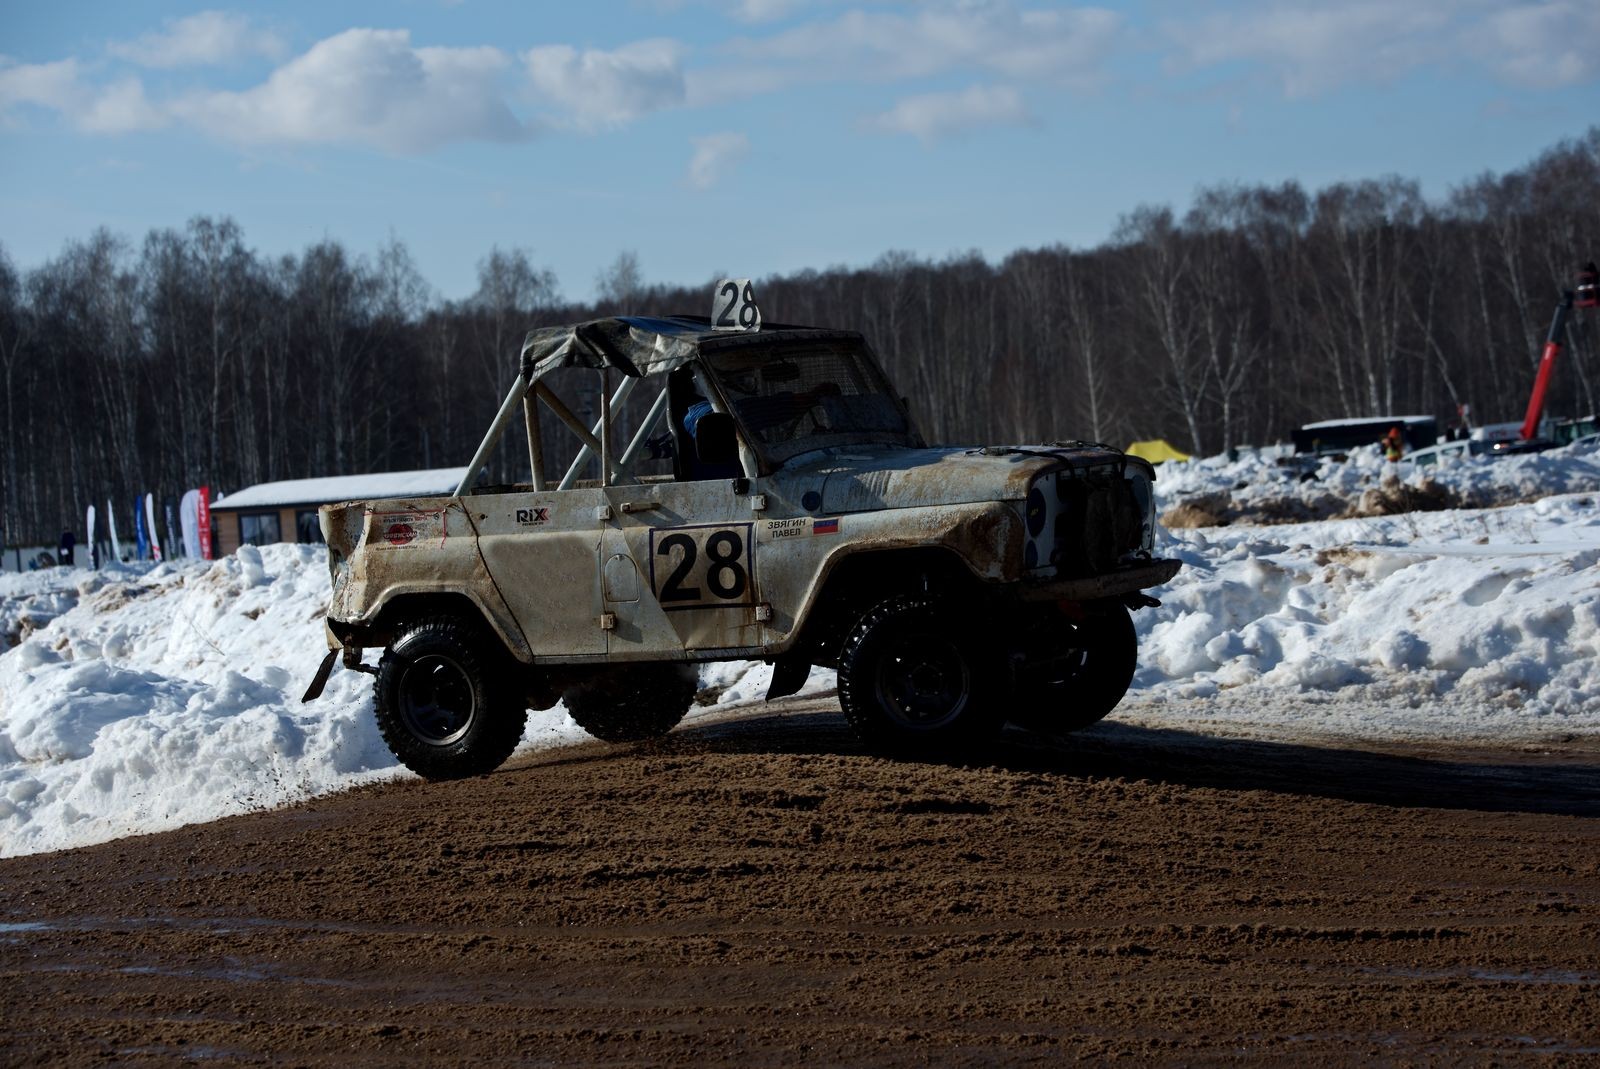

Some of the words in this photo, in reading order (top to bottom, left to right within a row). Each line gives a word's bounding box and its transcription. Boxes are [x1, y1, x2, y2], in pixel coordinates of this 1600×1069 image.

[716, 281, 758, 328] 28
[767, 519, 806, 530] ЗВЯГИН
[772, 528, 801, 539] ПАВЕЛ
[657, 530, 747, 600] 28
